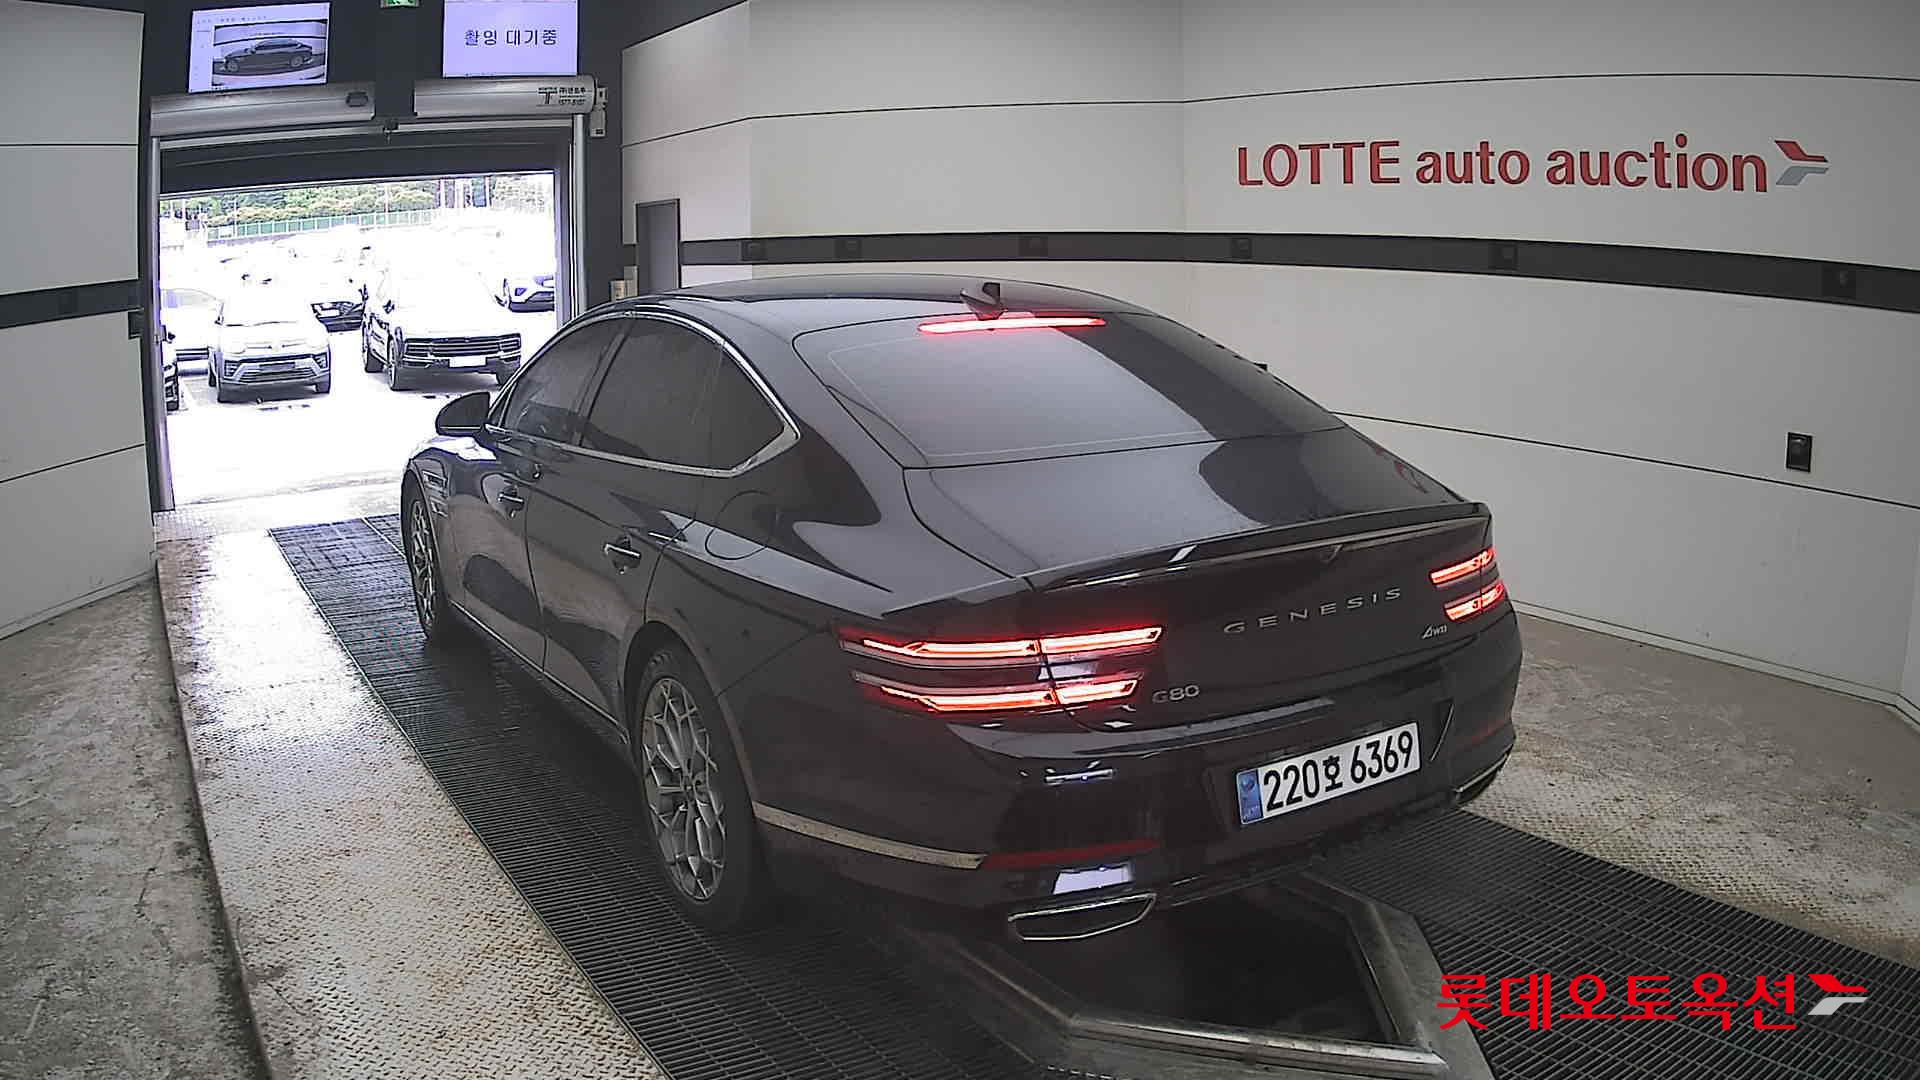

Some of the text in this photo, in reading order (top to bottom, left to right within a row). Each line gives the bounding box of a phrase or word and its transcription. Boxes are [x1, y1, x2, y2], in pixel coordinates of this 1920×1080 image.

[505, 29, 557, 46] 대기중
[1238, 133, 1768, 193] LOTTE auto auction
[1223, 587, 1401, 634] GENESIS
[1152, 684, 1200, 703] G80
[1263, 730, 1413, 811] 220호 6369
